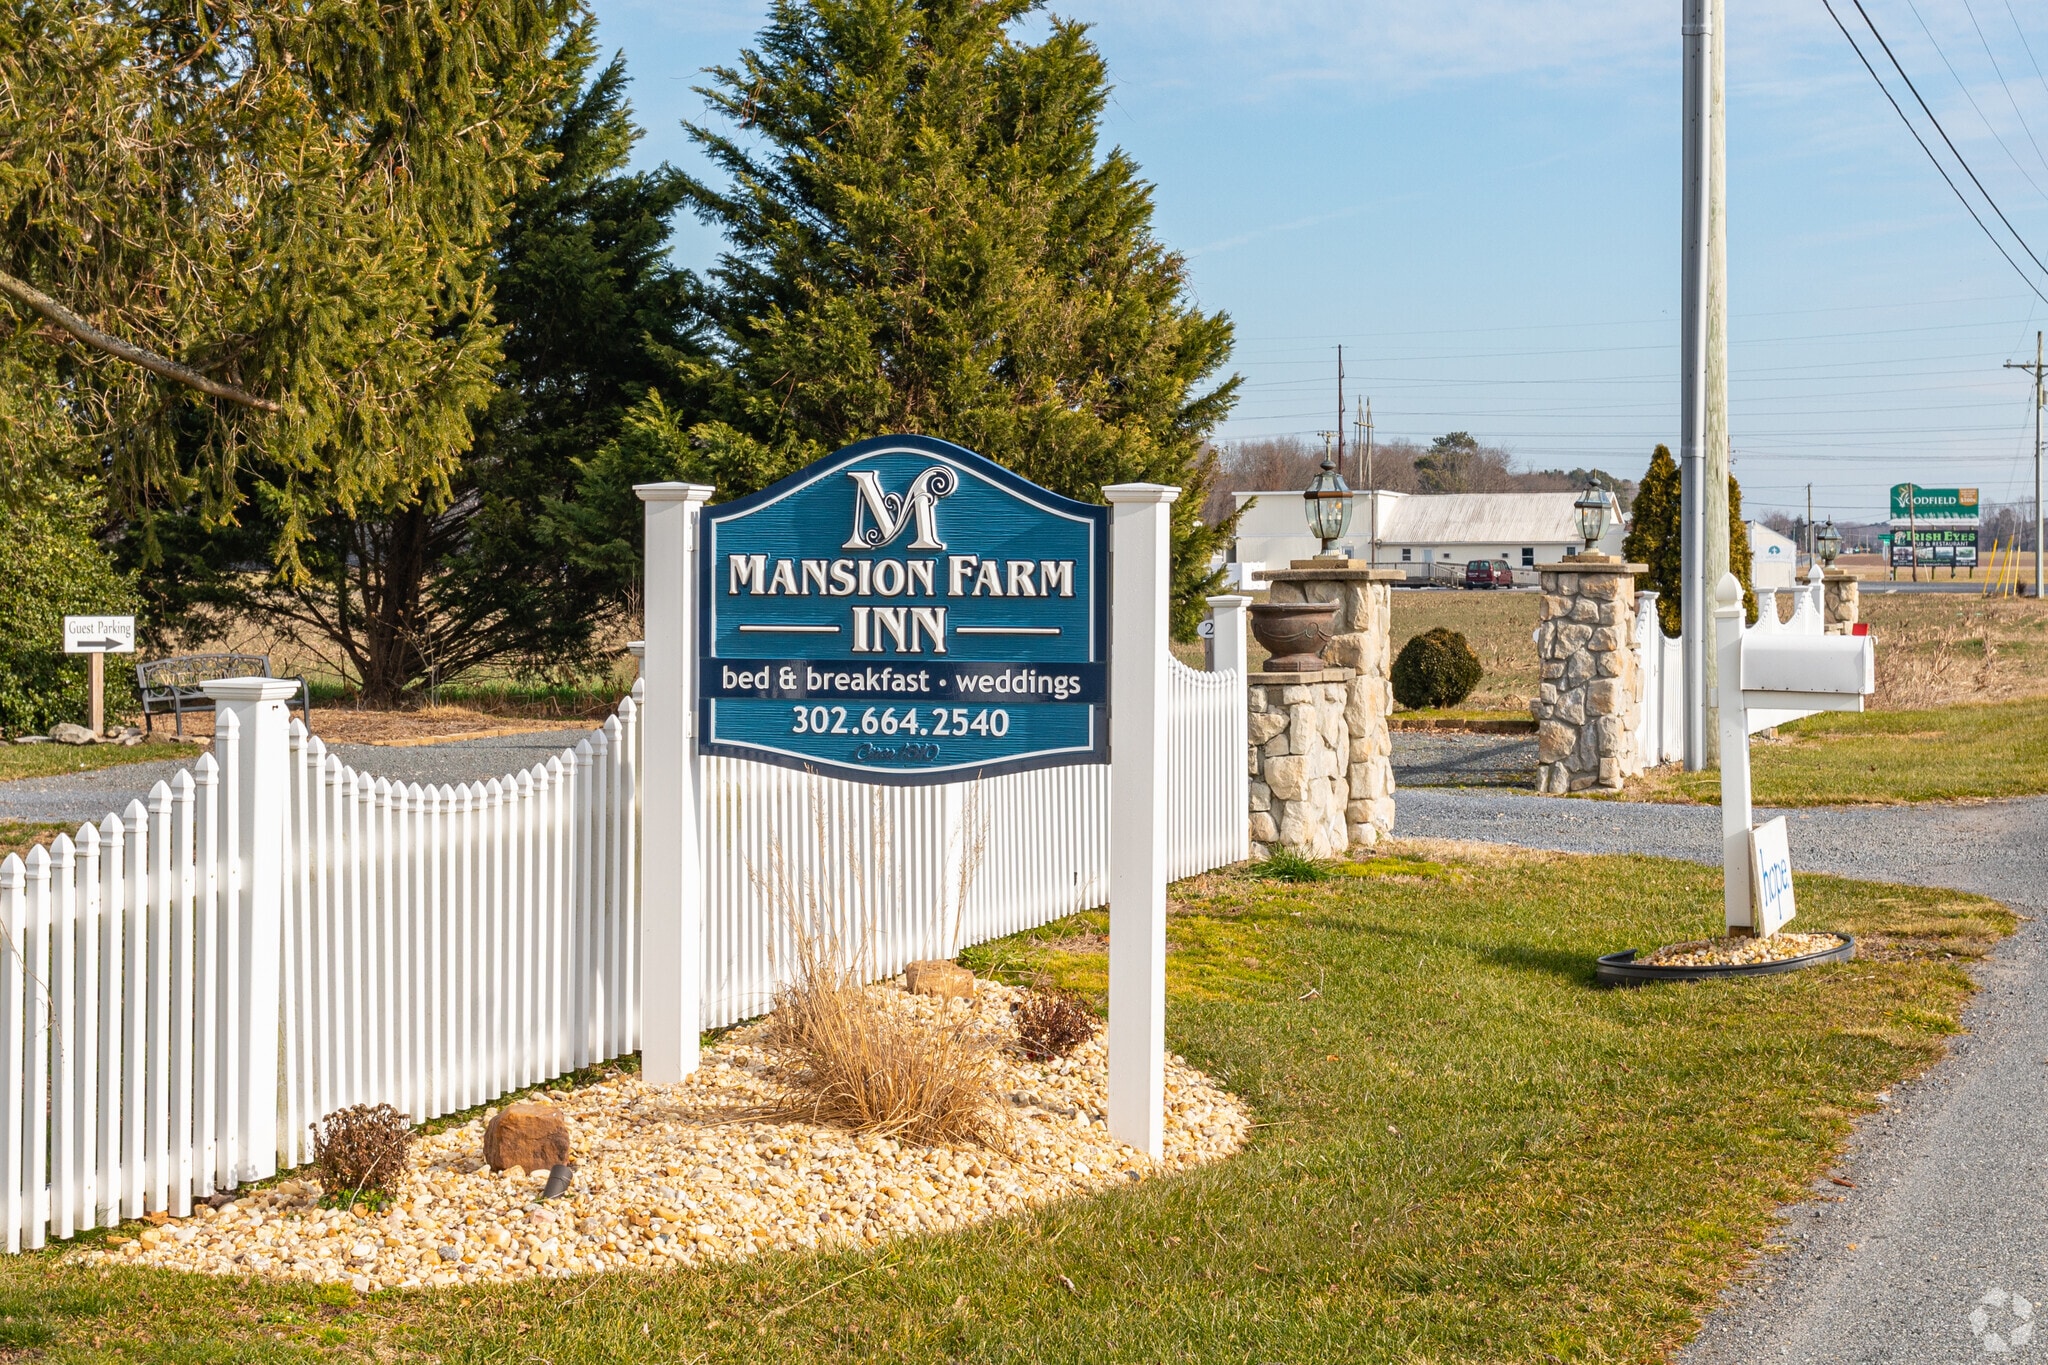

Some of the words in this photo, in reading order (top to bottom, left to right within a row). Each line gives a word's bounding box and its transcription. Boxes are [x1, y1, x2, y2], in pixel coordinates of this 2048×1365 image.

[841, 465, 960, 550] M
[1906, 531, 1941, 541] IRISH
[1944, 531, 1976, 541] EYES
[728, 553, 935, 597] MANSION
[947, 554, 1075, 598] FARM
[68, 620, 94, 634] Guest
[98, 620, 131, 638] Parking
[851, 606, 948, 653] INN
[722, 666, 770, 690] bed
[778, 667, 797, 691] &
[807, 667, 930, 692] breakfast
[956, 670, 1081, 700] weddings
[792, 706, 1010, 737] 302.664.2540
